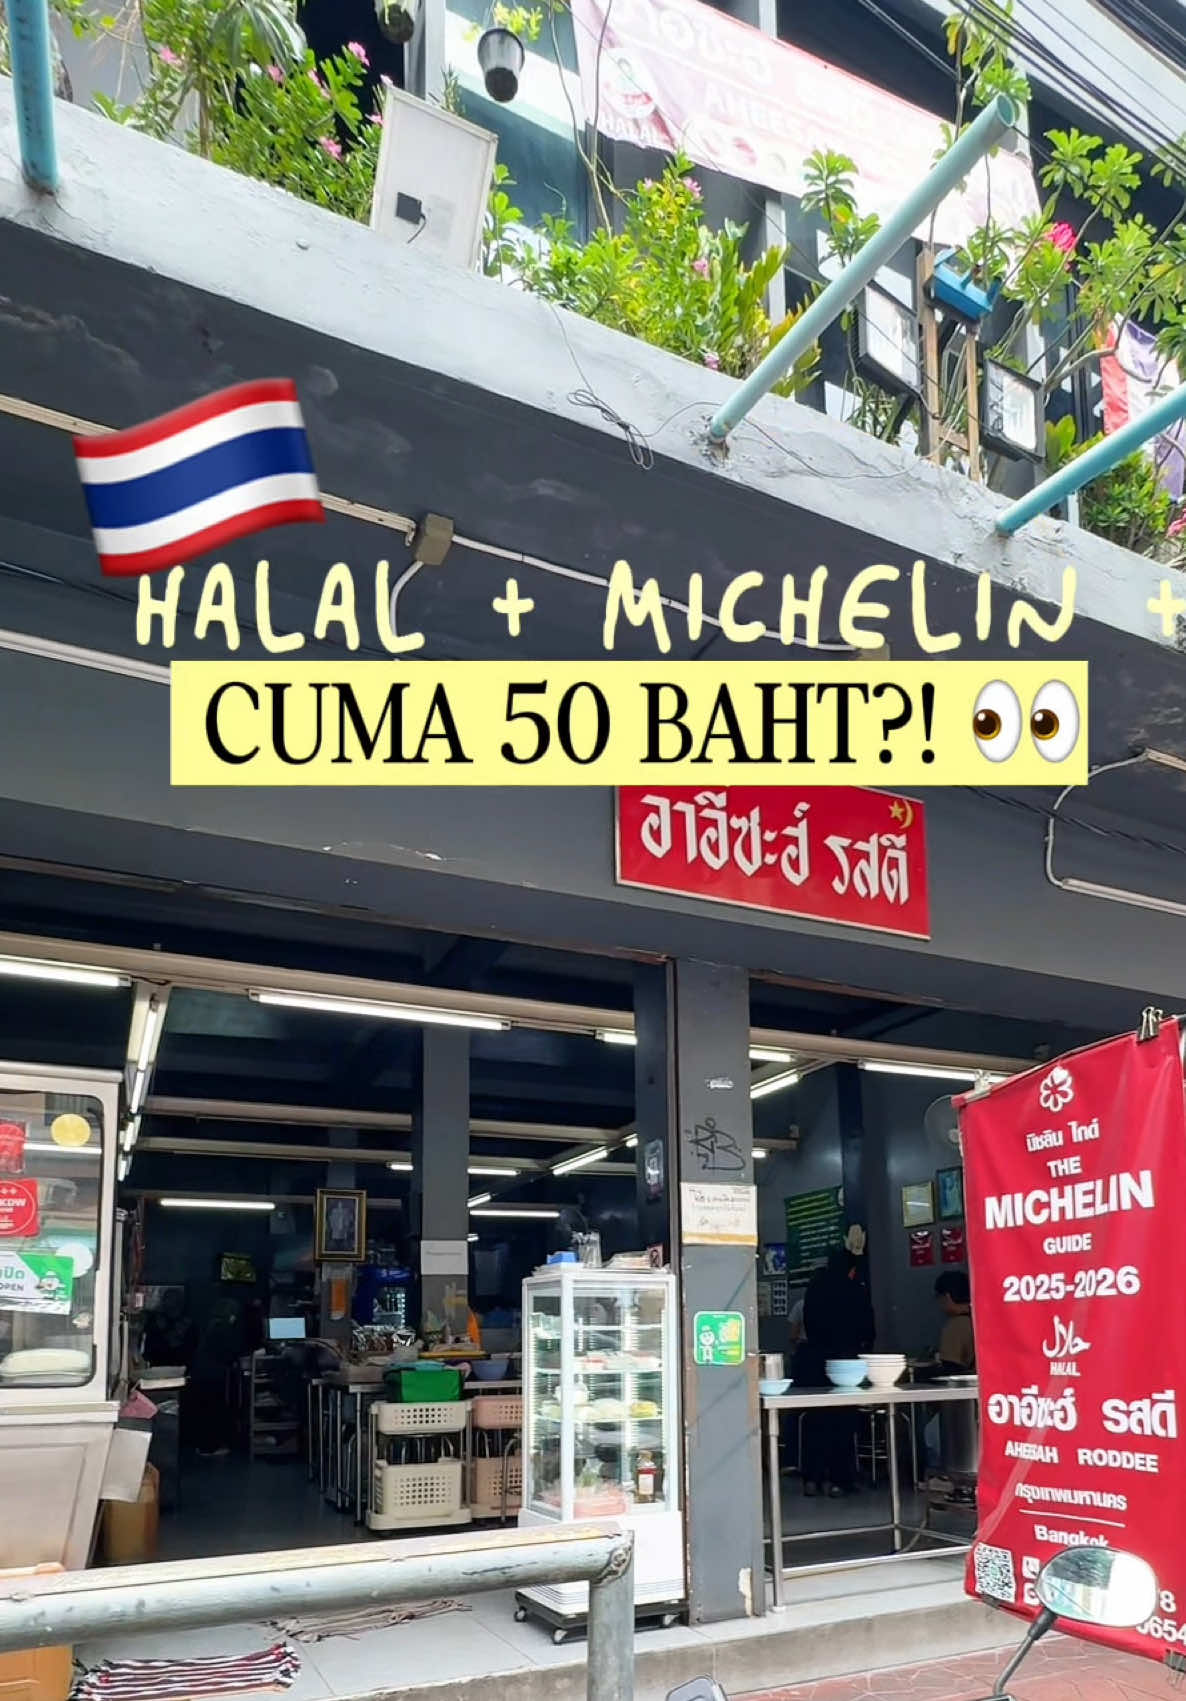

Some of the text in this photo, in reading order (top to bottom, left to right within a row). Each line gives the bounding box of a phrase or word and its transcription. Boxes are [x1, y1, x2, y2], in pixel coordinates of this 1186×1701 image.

[824, 833, 909, 906] รสดี
[1047, 1156, 1082, 1178] THE
[984, 1169, 1155, 1230] MICHELIN
[1043, 1233, 1092, 1255] GUIDE
[1003, 1265, 1141, 1302] 2025-2026
[1042, 1315, 1091, 1358] حلال
[1050, 1361, 1080, 1376] HALAL
[1101, 1389, 1177, 1438] รสดี
[1077, 1448, 1159, 1473] RODDEE
